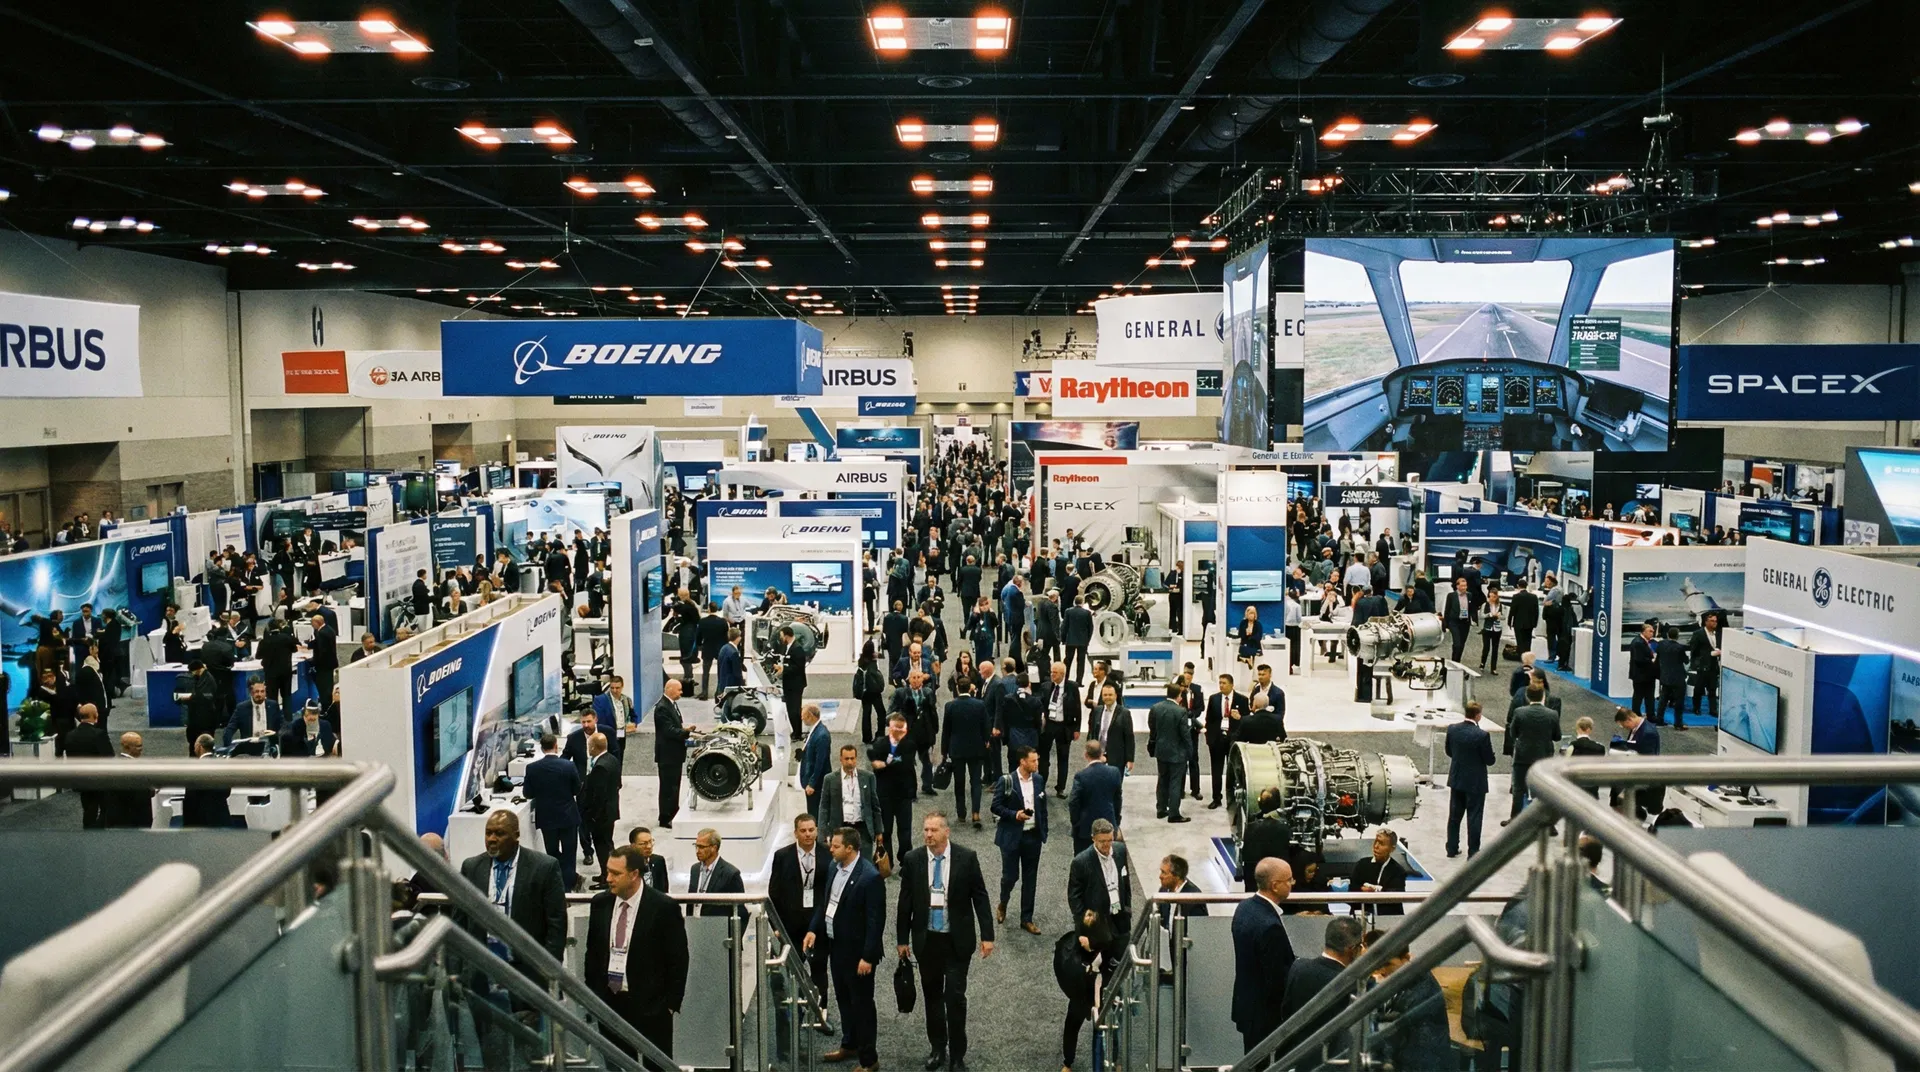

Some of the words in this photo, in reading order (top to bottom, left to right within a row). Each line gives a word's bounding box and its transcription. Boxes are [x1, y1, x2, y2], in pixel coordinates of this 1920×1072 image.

[1125, 319, 1206, 339] GENERAL
[0, 323, 106, 371] RBUS
[563, 344, 722, 364] BOEING
[1708, 365, 1916, 394] SPACEX
[1060, 377, 1188, 403] Raytheon
[835, 473, 888, 483] AIRBUS
[1053, 474, 1099, 484] Raytheon
[1054, 498, 1124, 511] SPACEX
[798, 525, 852, 533] BOEING
[140, 543, 167, 554] BOEING
[1763, 567, 1808, 592] GENERAL
[1837, 583, 1895, 613] ELECTRIC
[534, 607, 556, 628] BOEING
[428, 656, 462, 686] BOEING
